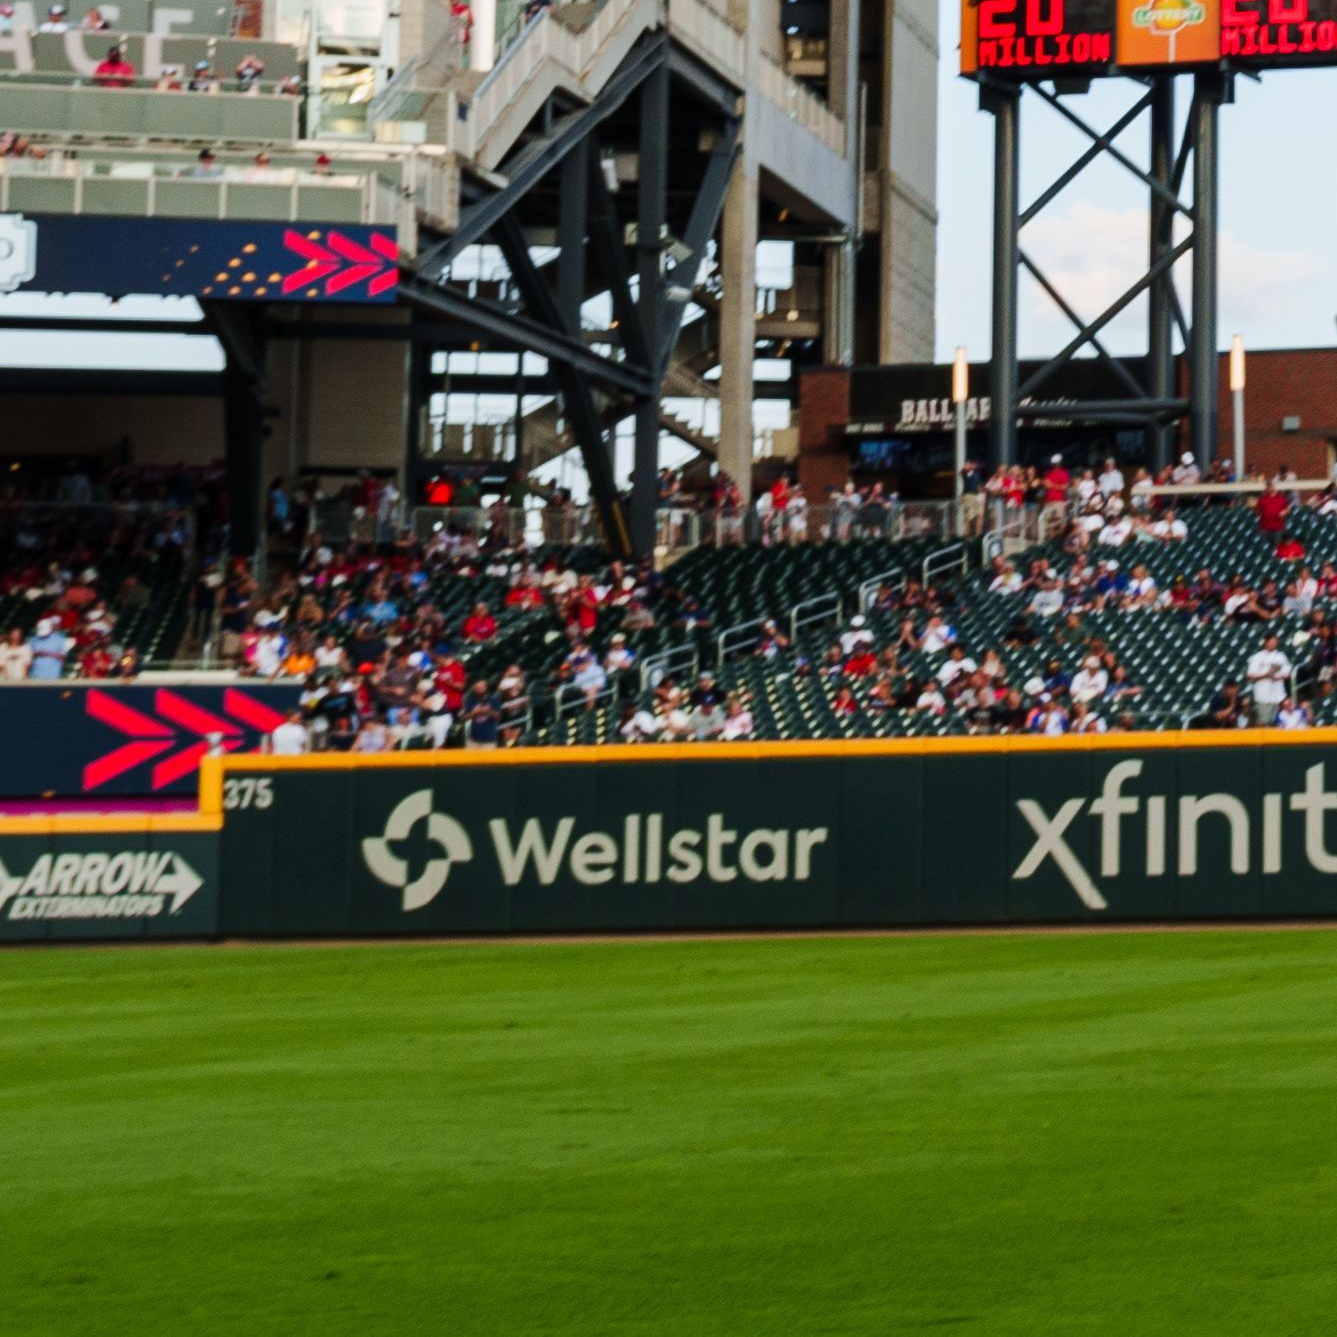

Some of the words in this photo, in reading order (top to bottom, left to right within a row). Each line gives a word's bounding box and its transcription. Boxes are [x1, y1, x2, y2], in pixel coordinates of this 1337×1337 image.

[978, 33, 1110, 67] MILLION
[223, 777, 273, 810] 375
[488, 813, 828, 886] Wellstar
[18, 851, 175, 896] ARROW
[8, 892, 165, 921] EXTERMINATORS
